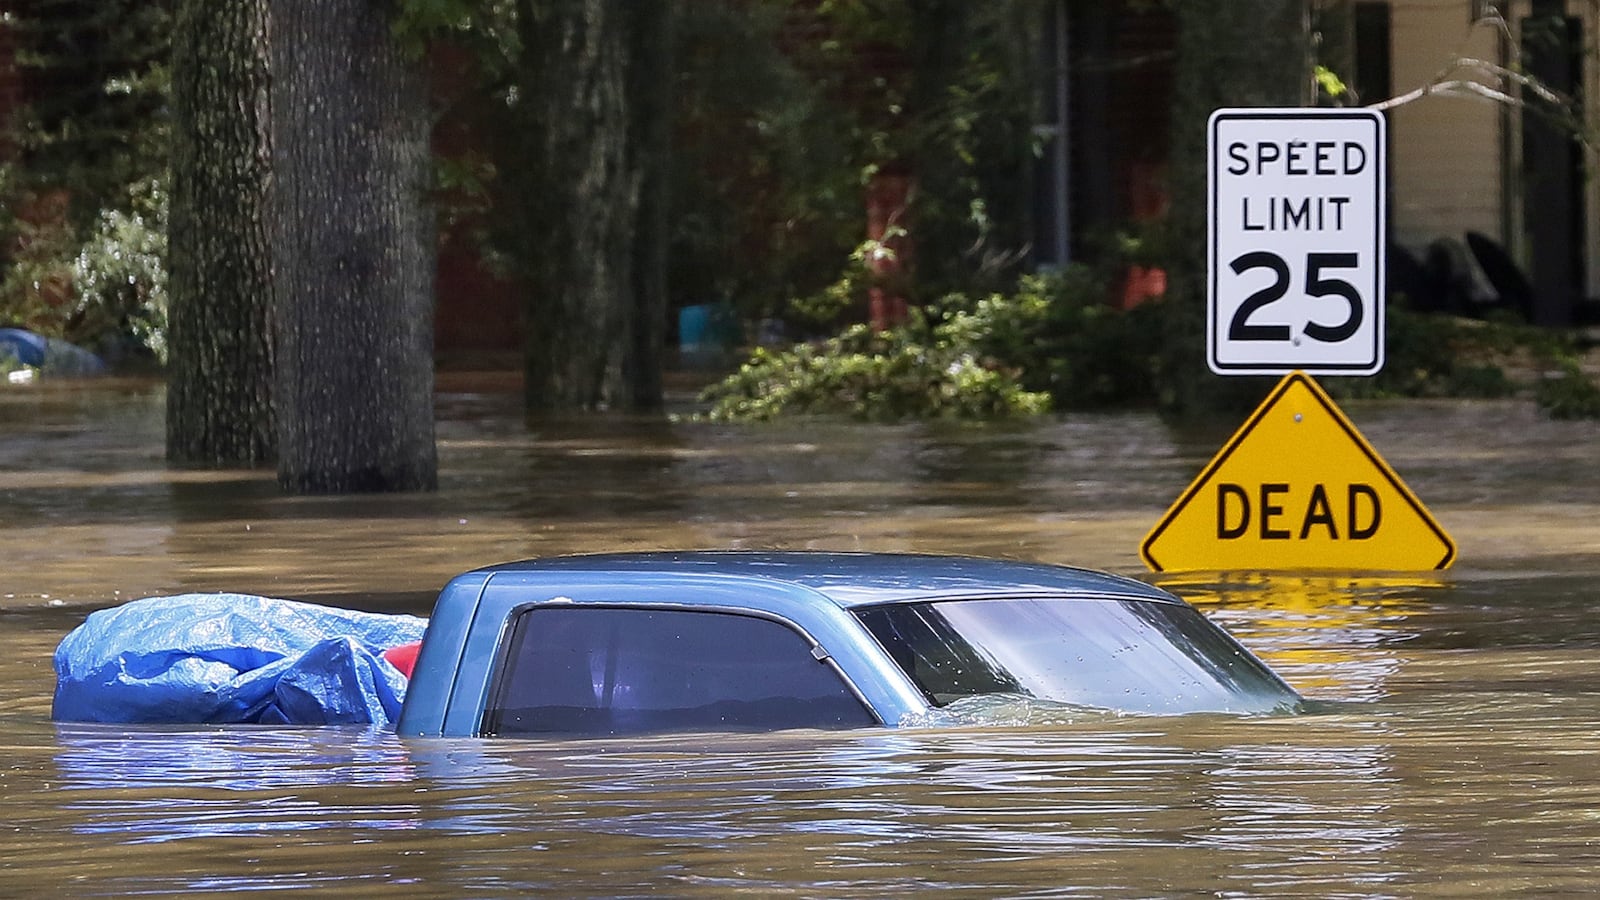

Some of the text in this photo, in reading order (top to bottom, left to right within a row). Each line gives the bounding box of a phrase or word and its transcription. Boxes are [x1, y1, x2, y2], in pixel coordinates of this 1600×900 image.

[1228, 142, 1366, 175] SPEED
[1243, 198, 1350, 231] LIMIT
[1229, 251, 1364, 342] 25
[1217, 484, 1382, 540] DEAD
